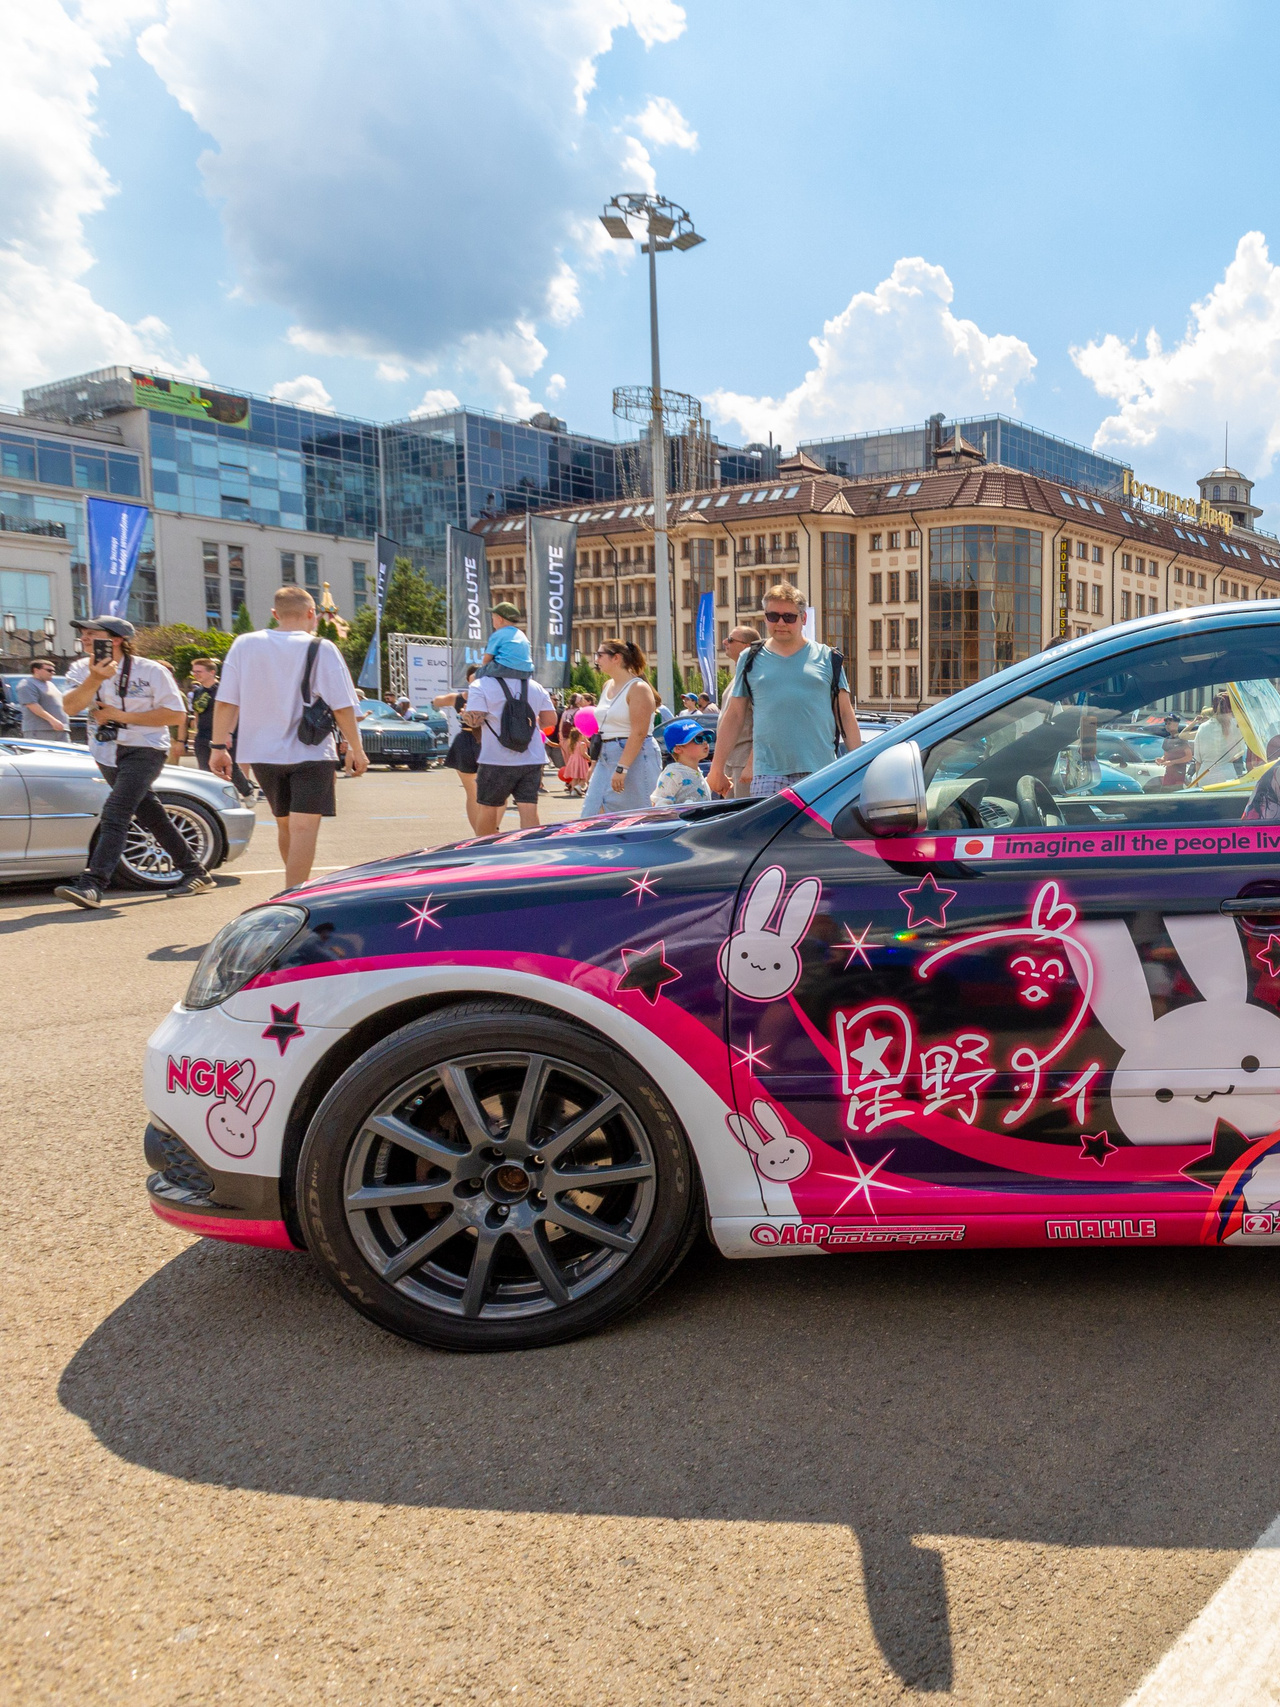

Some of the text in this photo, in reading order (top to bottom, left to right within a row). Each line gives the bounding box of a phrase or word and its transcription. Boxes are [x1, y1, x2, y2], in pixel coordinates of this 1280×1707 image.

[1123, 469, 1234, 536] Гостиный Двор
[465, 556, 481, 640] EVOLUTE
[549, 545, 564, 635] EVOLUTE
[1005, 837, 1095, 857] imagine
[1101, 835, 1126, 851] all
[1132, 836, 1168, 851] the
[1174, 832, 1250, 854] people
[167, 1054, 243, 1102] NGK
[779, 1223, 966, 1246] AGP motorsport
[1046, 1219, 1157, 1240] MAHLE
